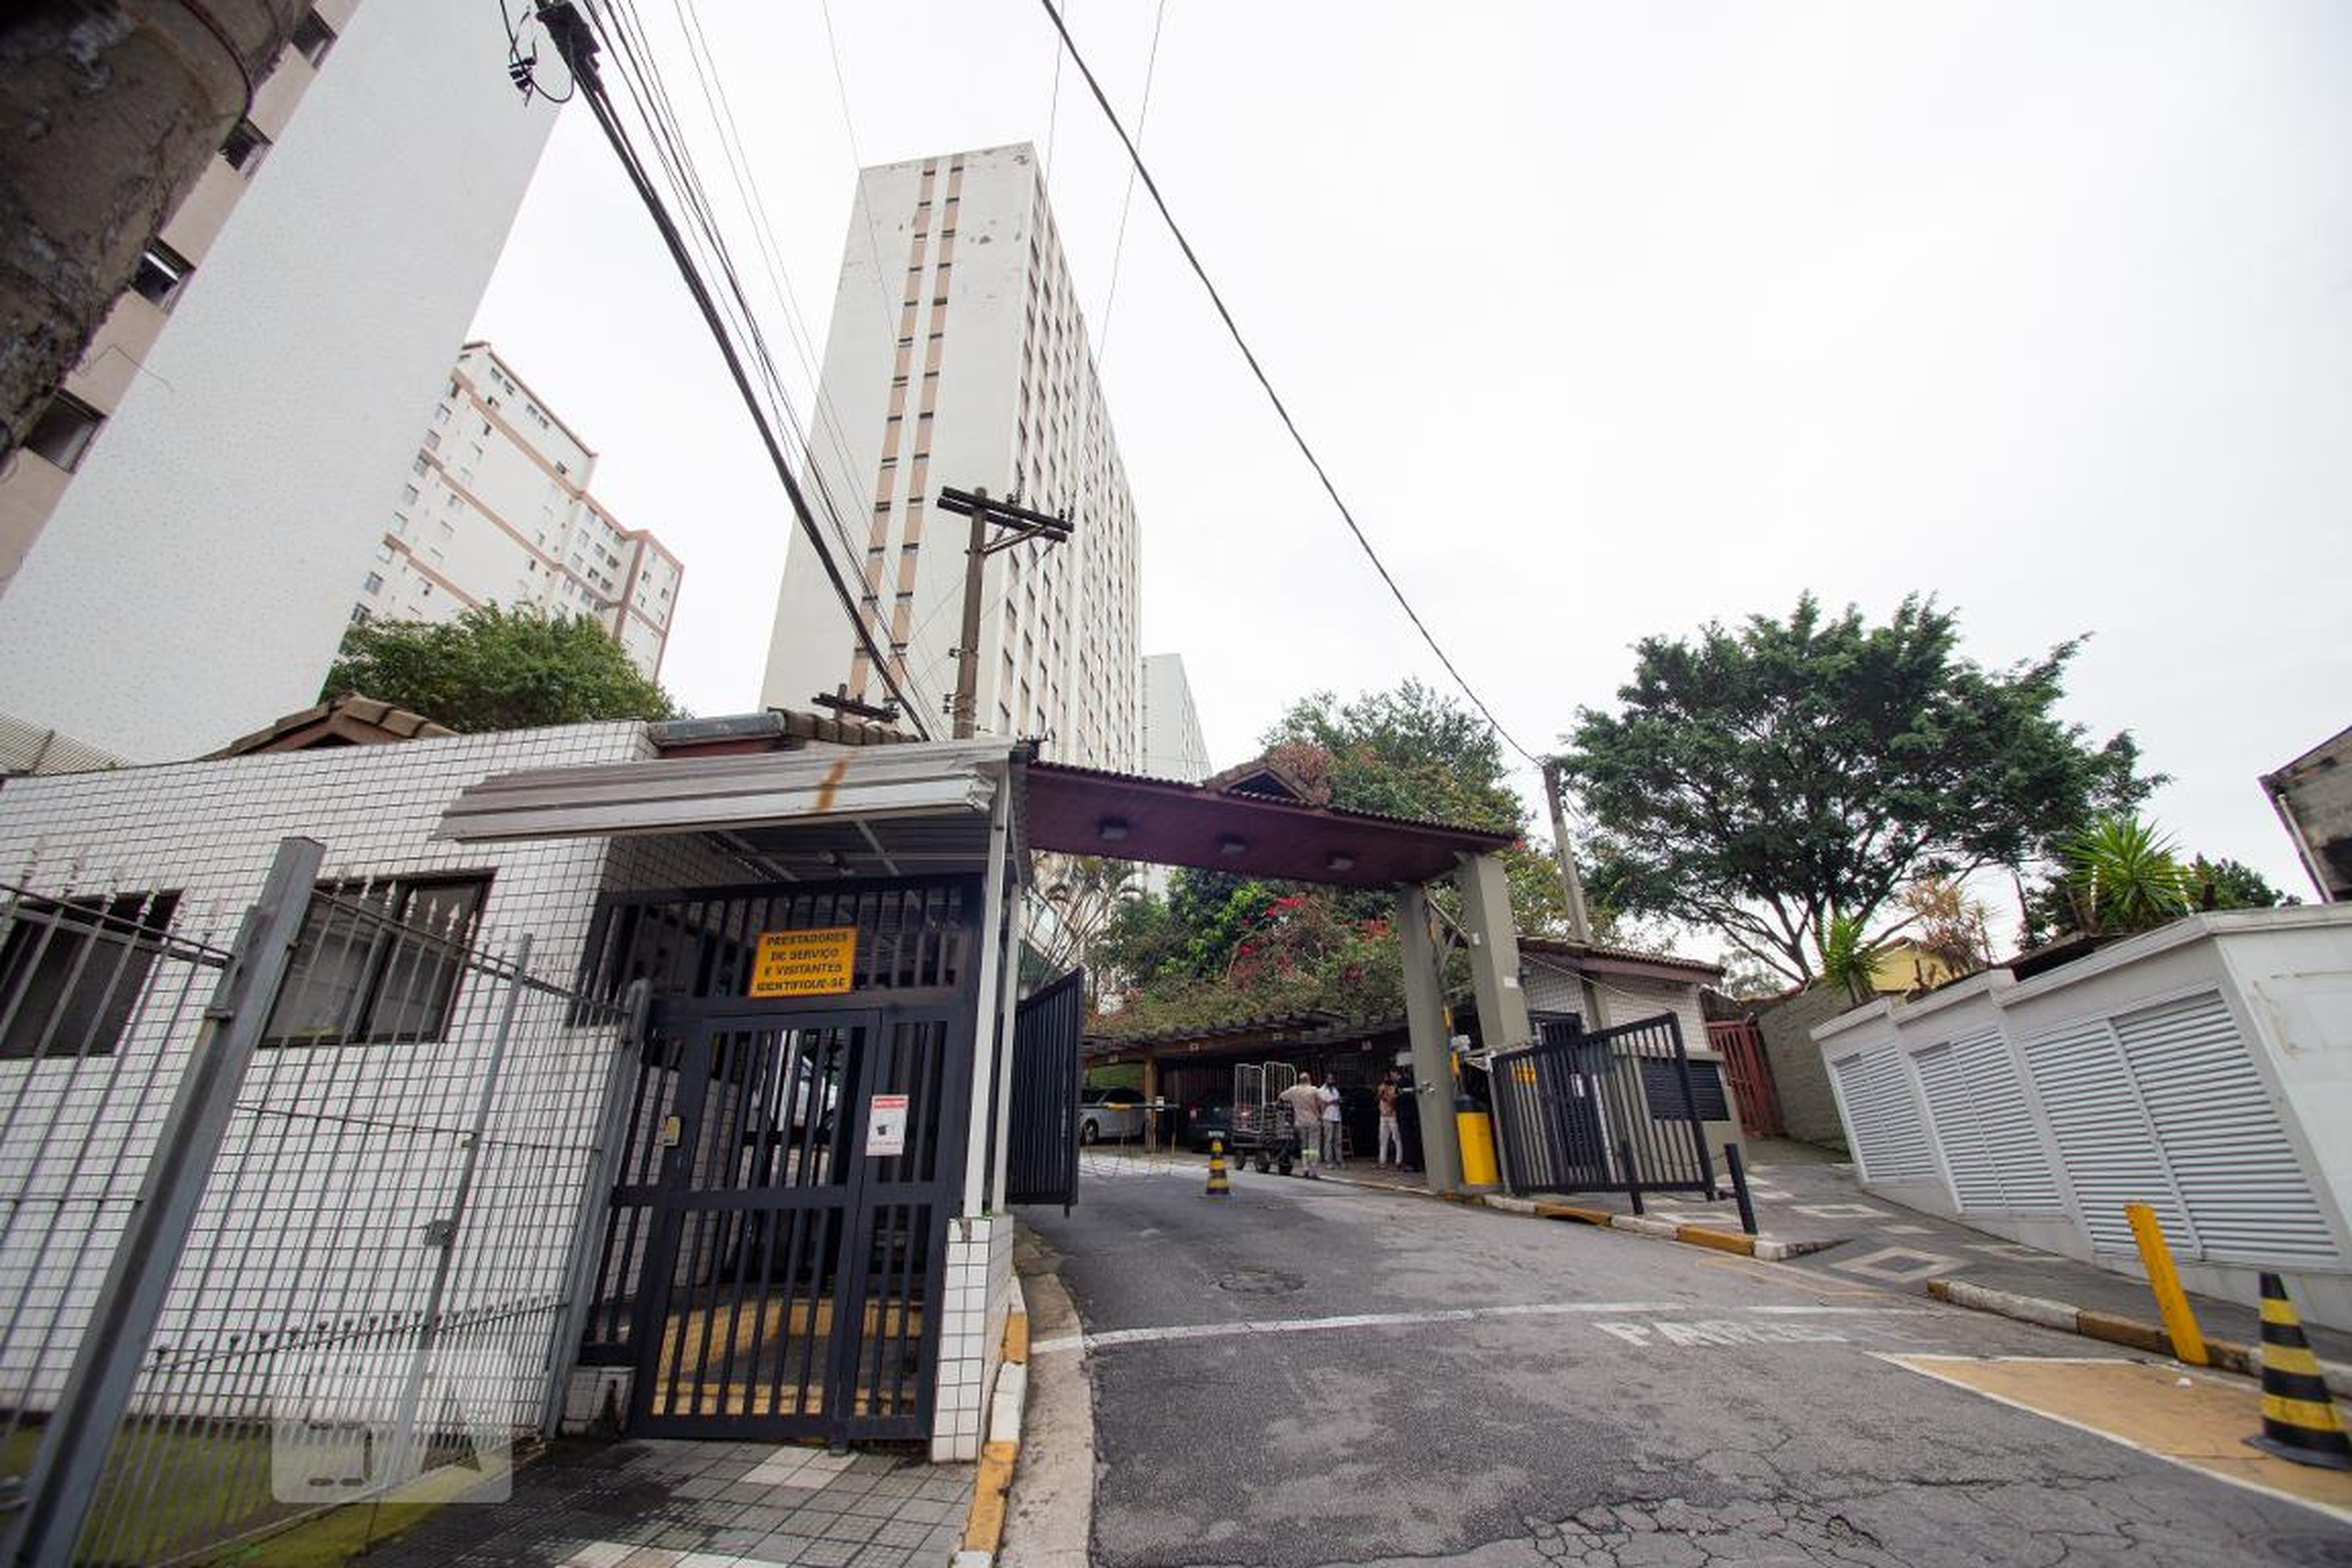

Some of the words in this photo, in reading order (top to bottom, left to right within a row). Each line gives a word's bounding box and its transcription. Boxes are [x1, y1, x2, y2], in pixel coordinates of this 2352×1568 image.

[771, 951, 786, 961] DE
[790, 948, 839, 960] SERVIÇO
[777, 963, 842, 975] VISITANTES
